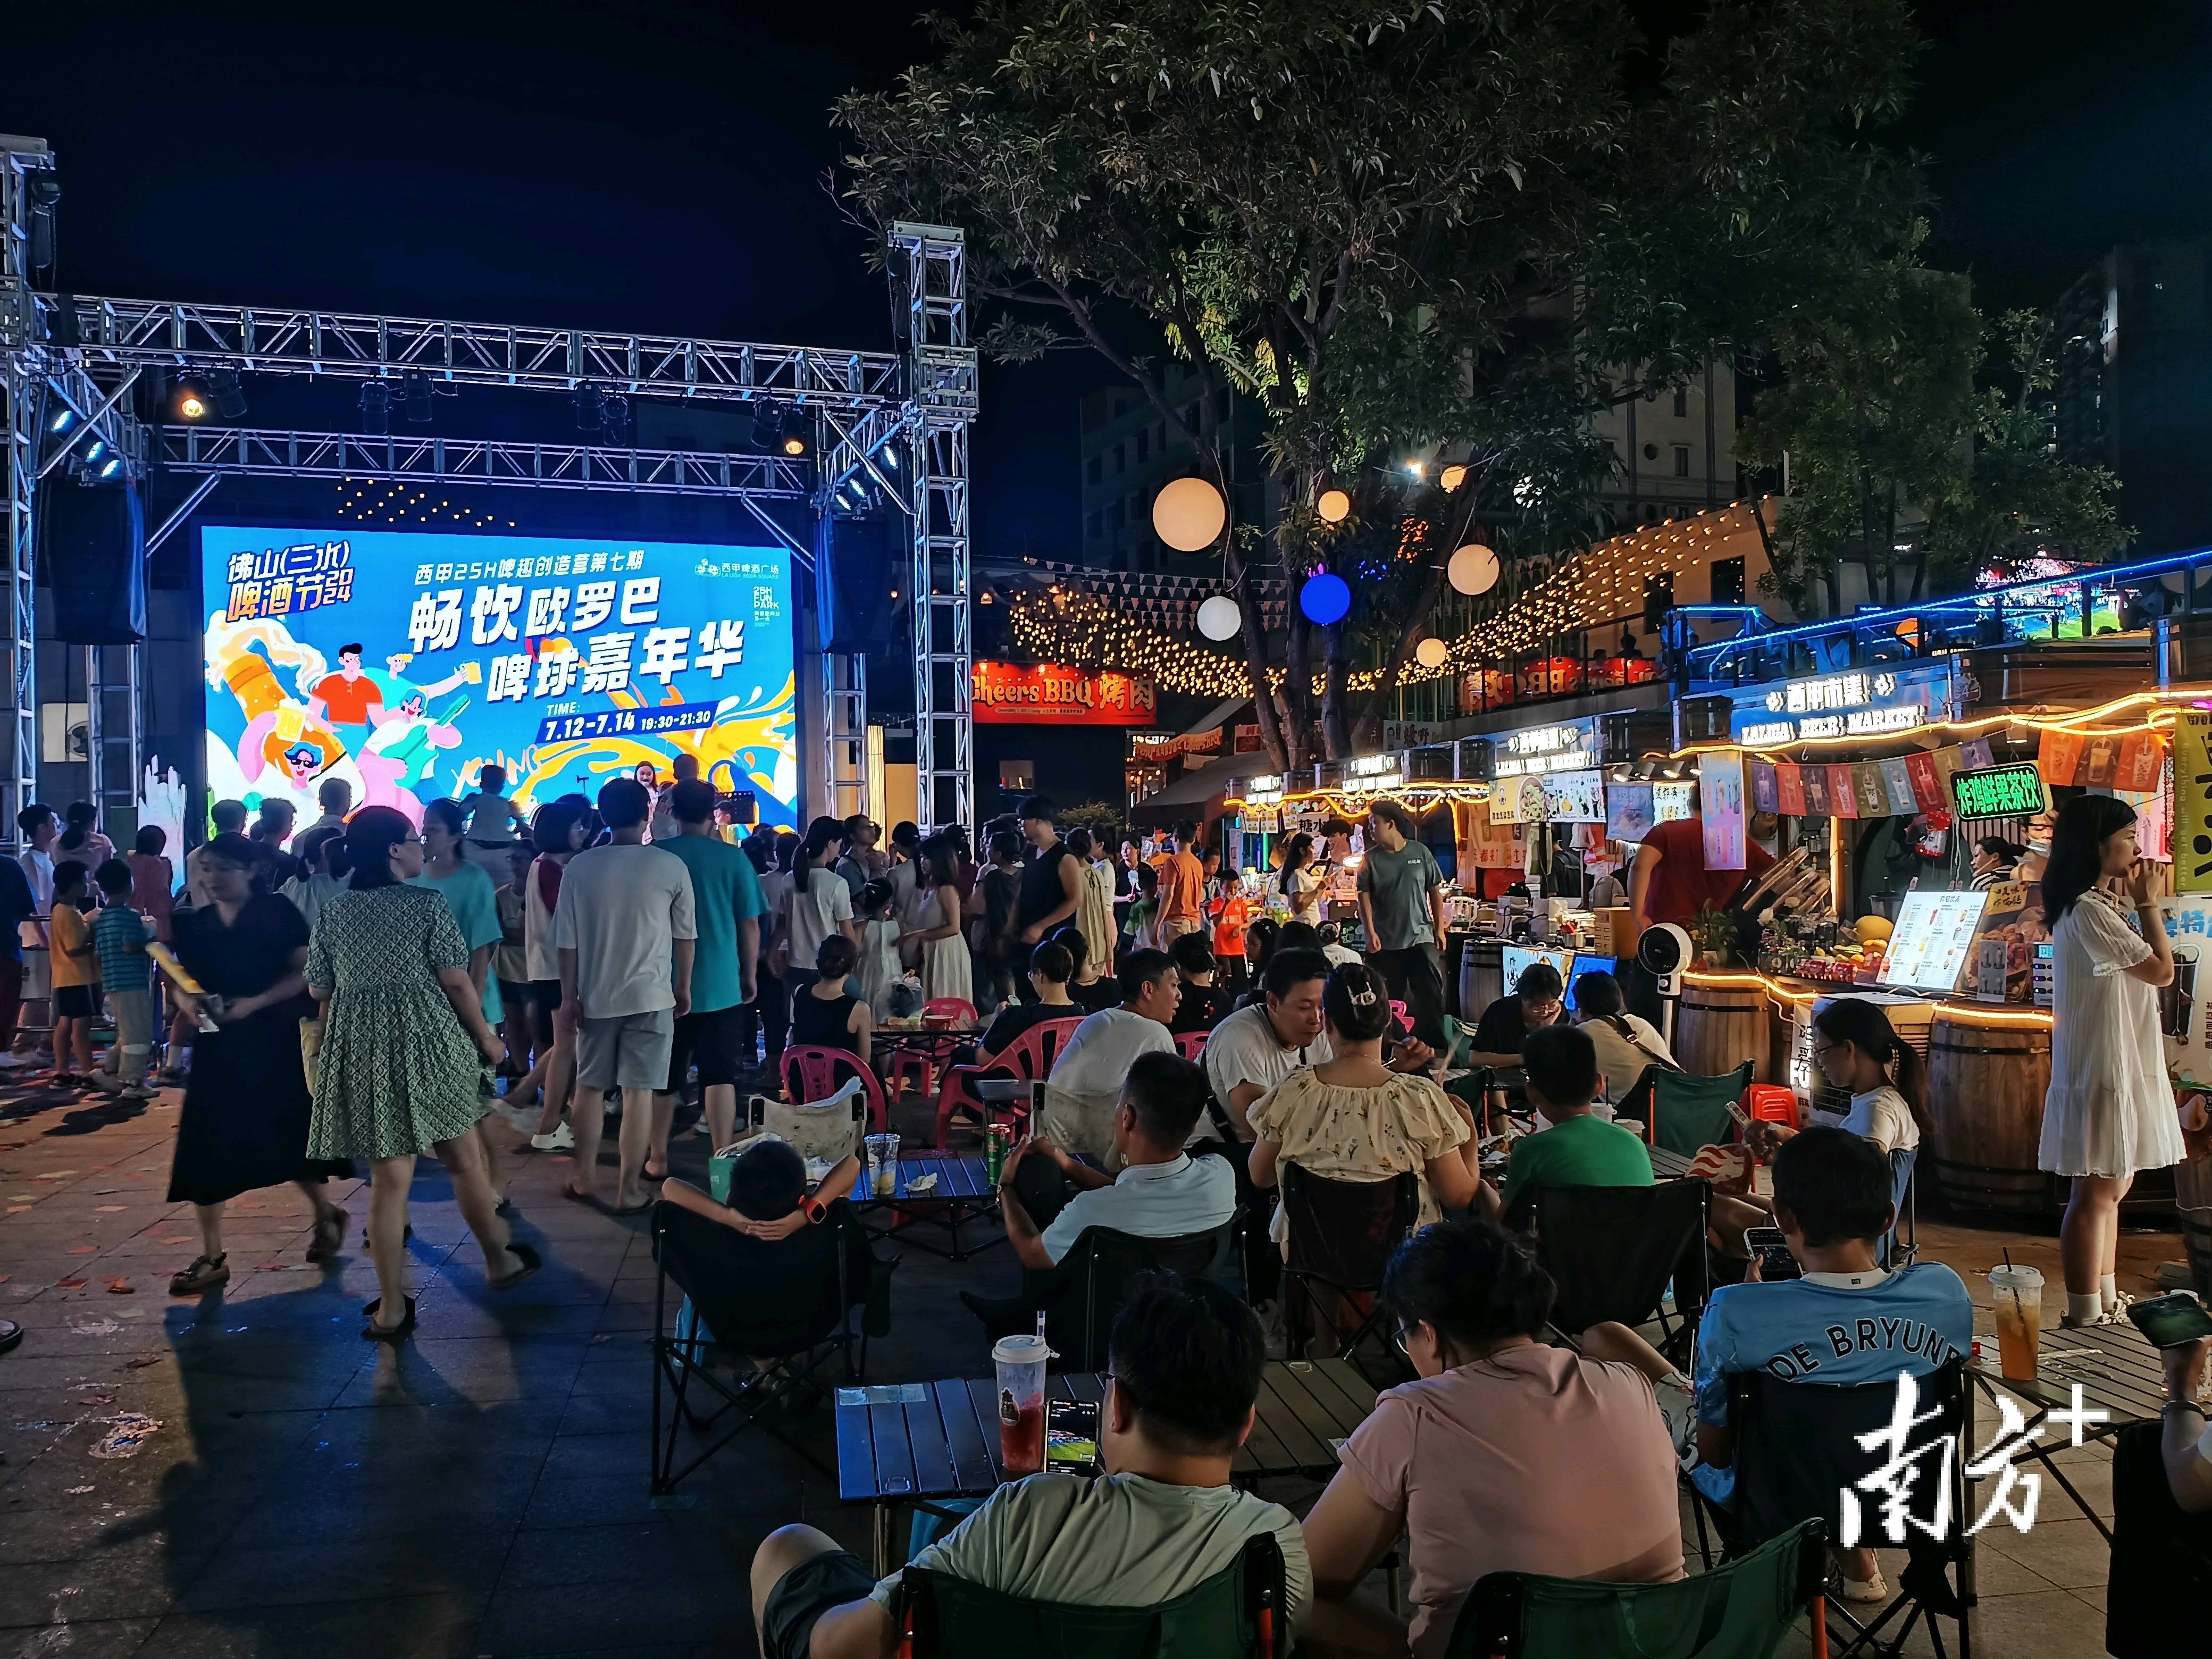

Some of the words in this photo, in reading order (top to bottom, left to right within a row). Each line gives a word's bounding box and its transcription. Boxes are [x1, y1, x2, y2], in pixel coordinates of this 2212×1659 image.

[228, 541, 350, 583] 佛山(三水)
[415, 550, 644, 585] 西甲25H啤趣创造营第七期
[722, 563, 779, 574] 西甲啤酒广场
[227, 568, 325, 622] 啤酒节
[754, 593, 773, 602] FUN
[408, 577, 661, 653] 畅饮欧罗巴
[487, 619, 744, 702] 啤球嘉年华
[546, 702, 581, 717] TIME:
[1043, 678, 1094, 707] BBQ
[1099, 673, 1154, 710] 烤肉
[1787, 674, 1866, 713] 西甲市集
[546, 715, 635, 741] 7.12-7.14
[641, 710, 711, 731] 19:30-21:30
[1799, 715, 1847, 738] BEER
[1847, 705, 1929, 734] MARKET
[1956, 770, 2041, 815] 炸鸡鲜果茶饮
[1765, 1342, 1821, 1382] DE
